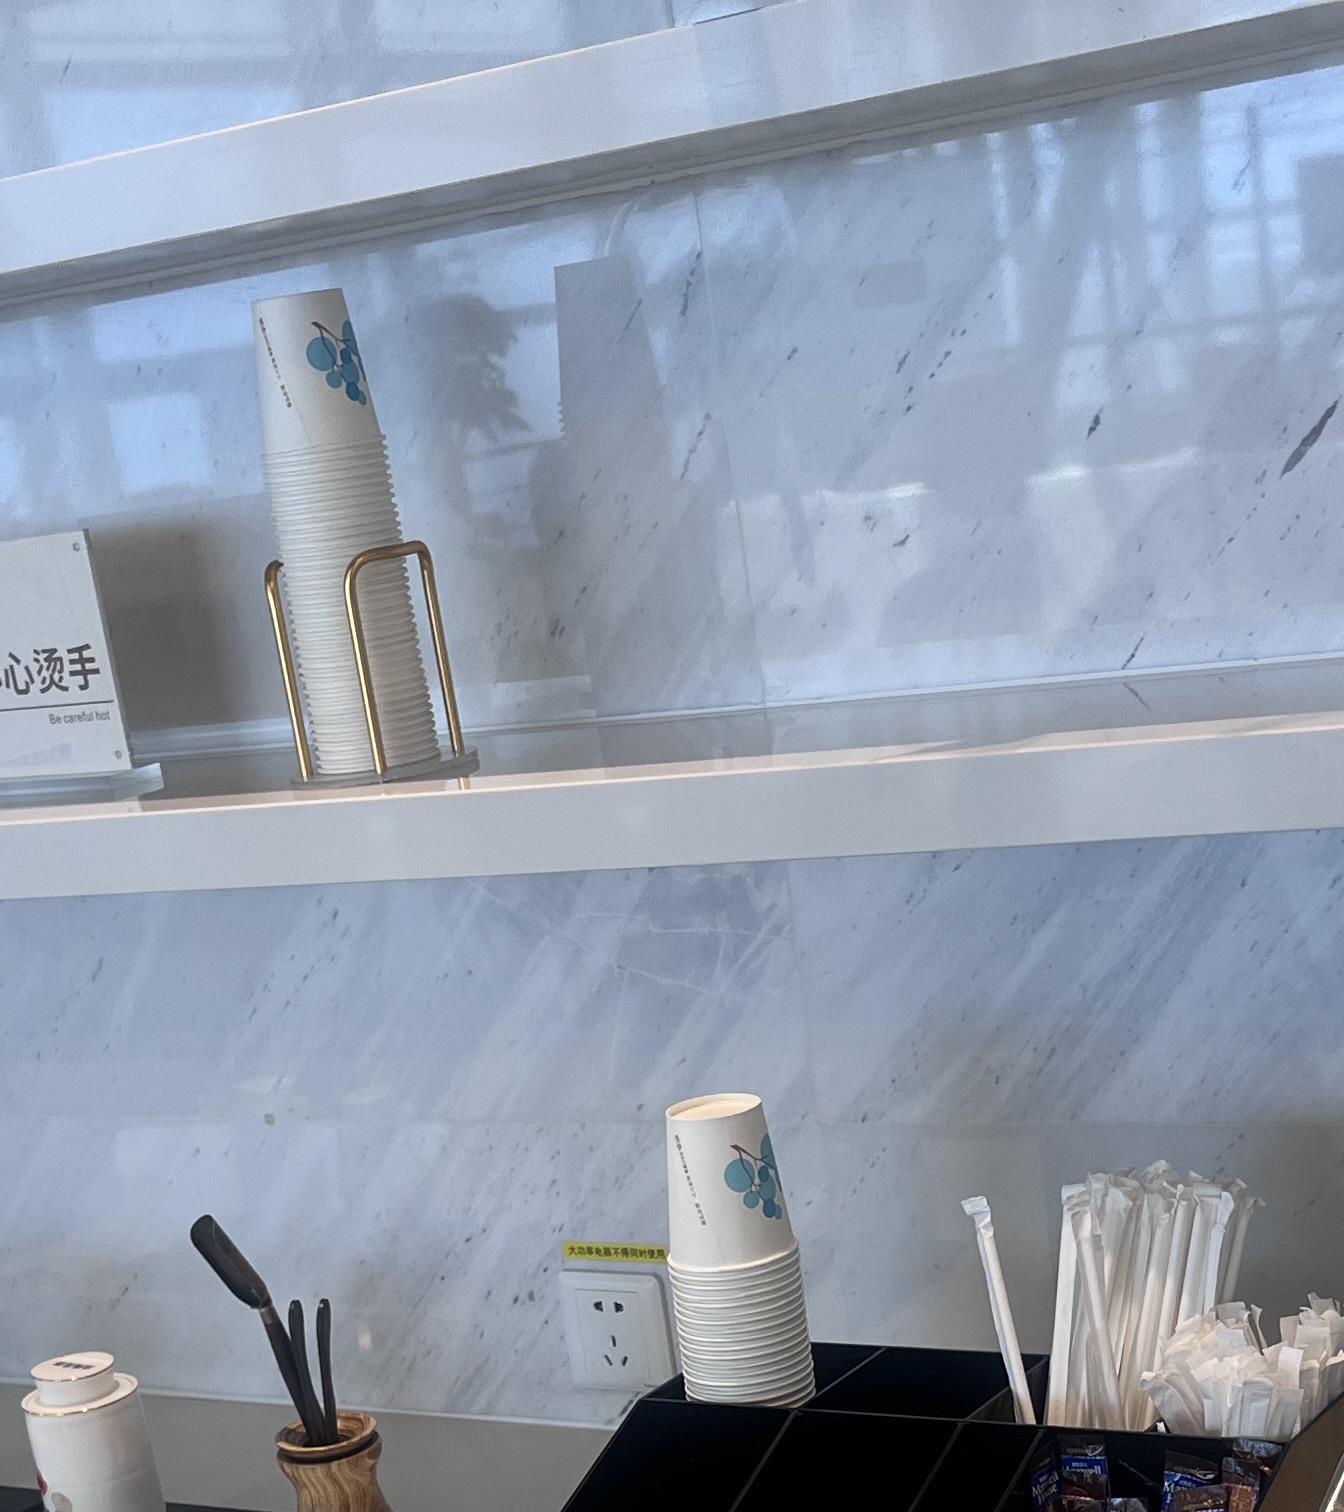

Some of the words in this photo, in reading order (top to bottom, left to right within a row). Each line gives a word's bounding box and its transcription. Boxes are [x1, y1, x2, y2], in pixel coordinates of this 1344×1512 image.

[48, 713, 62, 725] Be
[63, 710, 94, 724] careful
[95, 709, 111, 721] hot
[567, 1245, 666, 1260] 大功率电器不得同时使用
